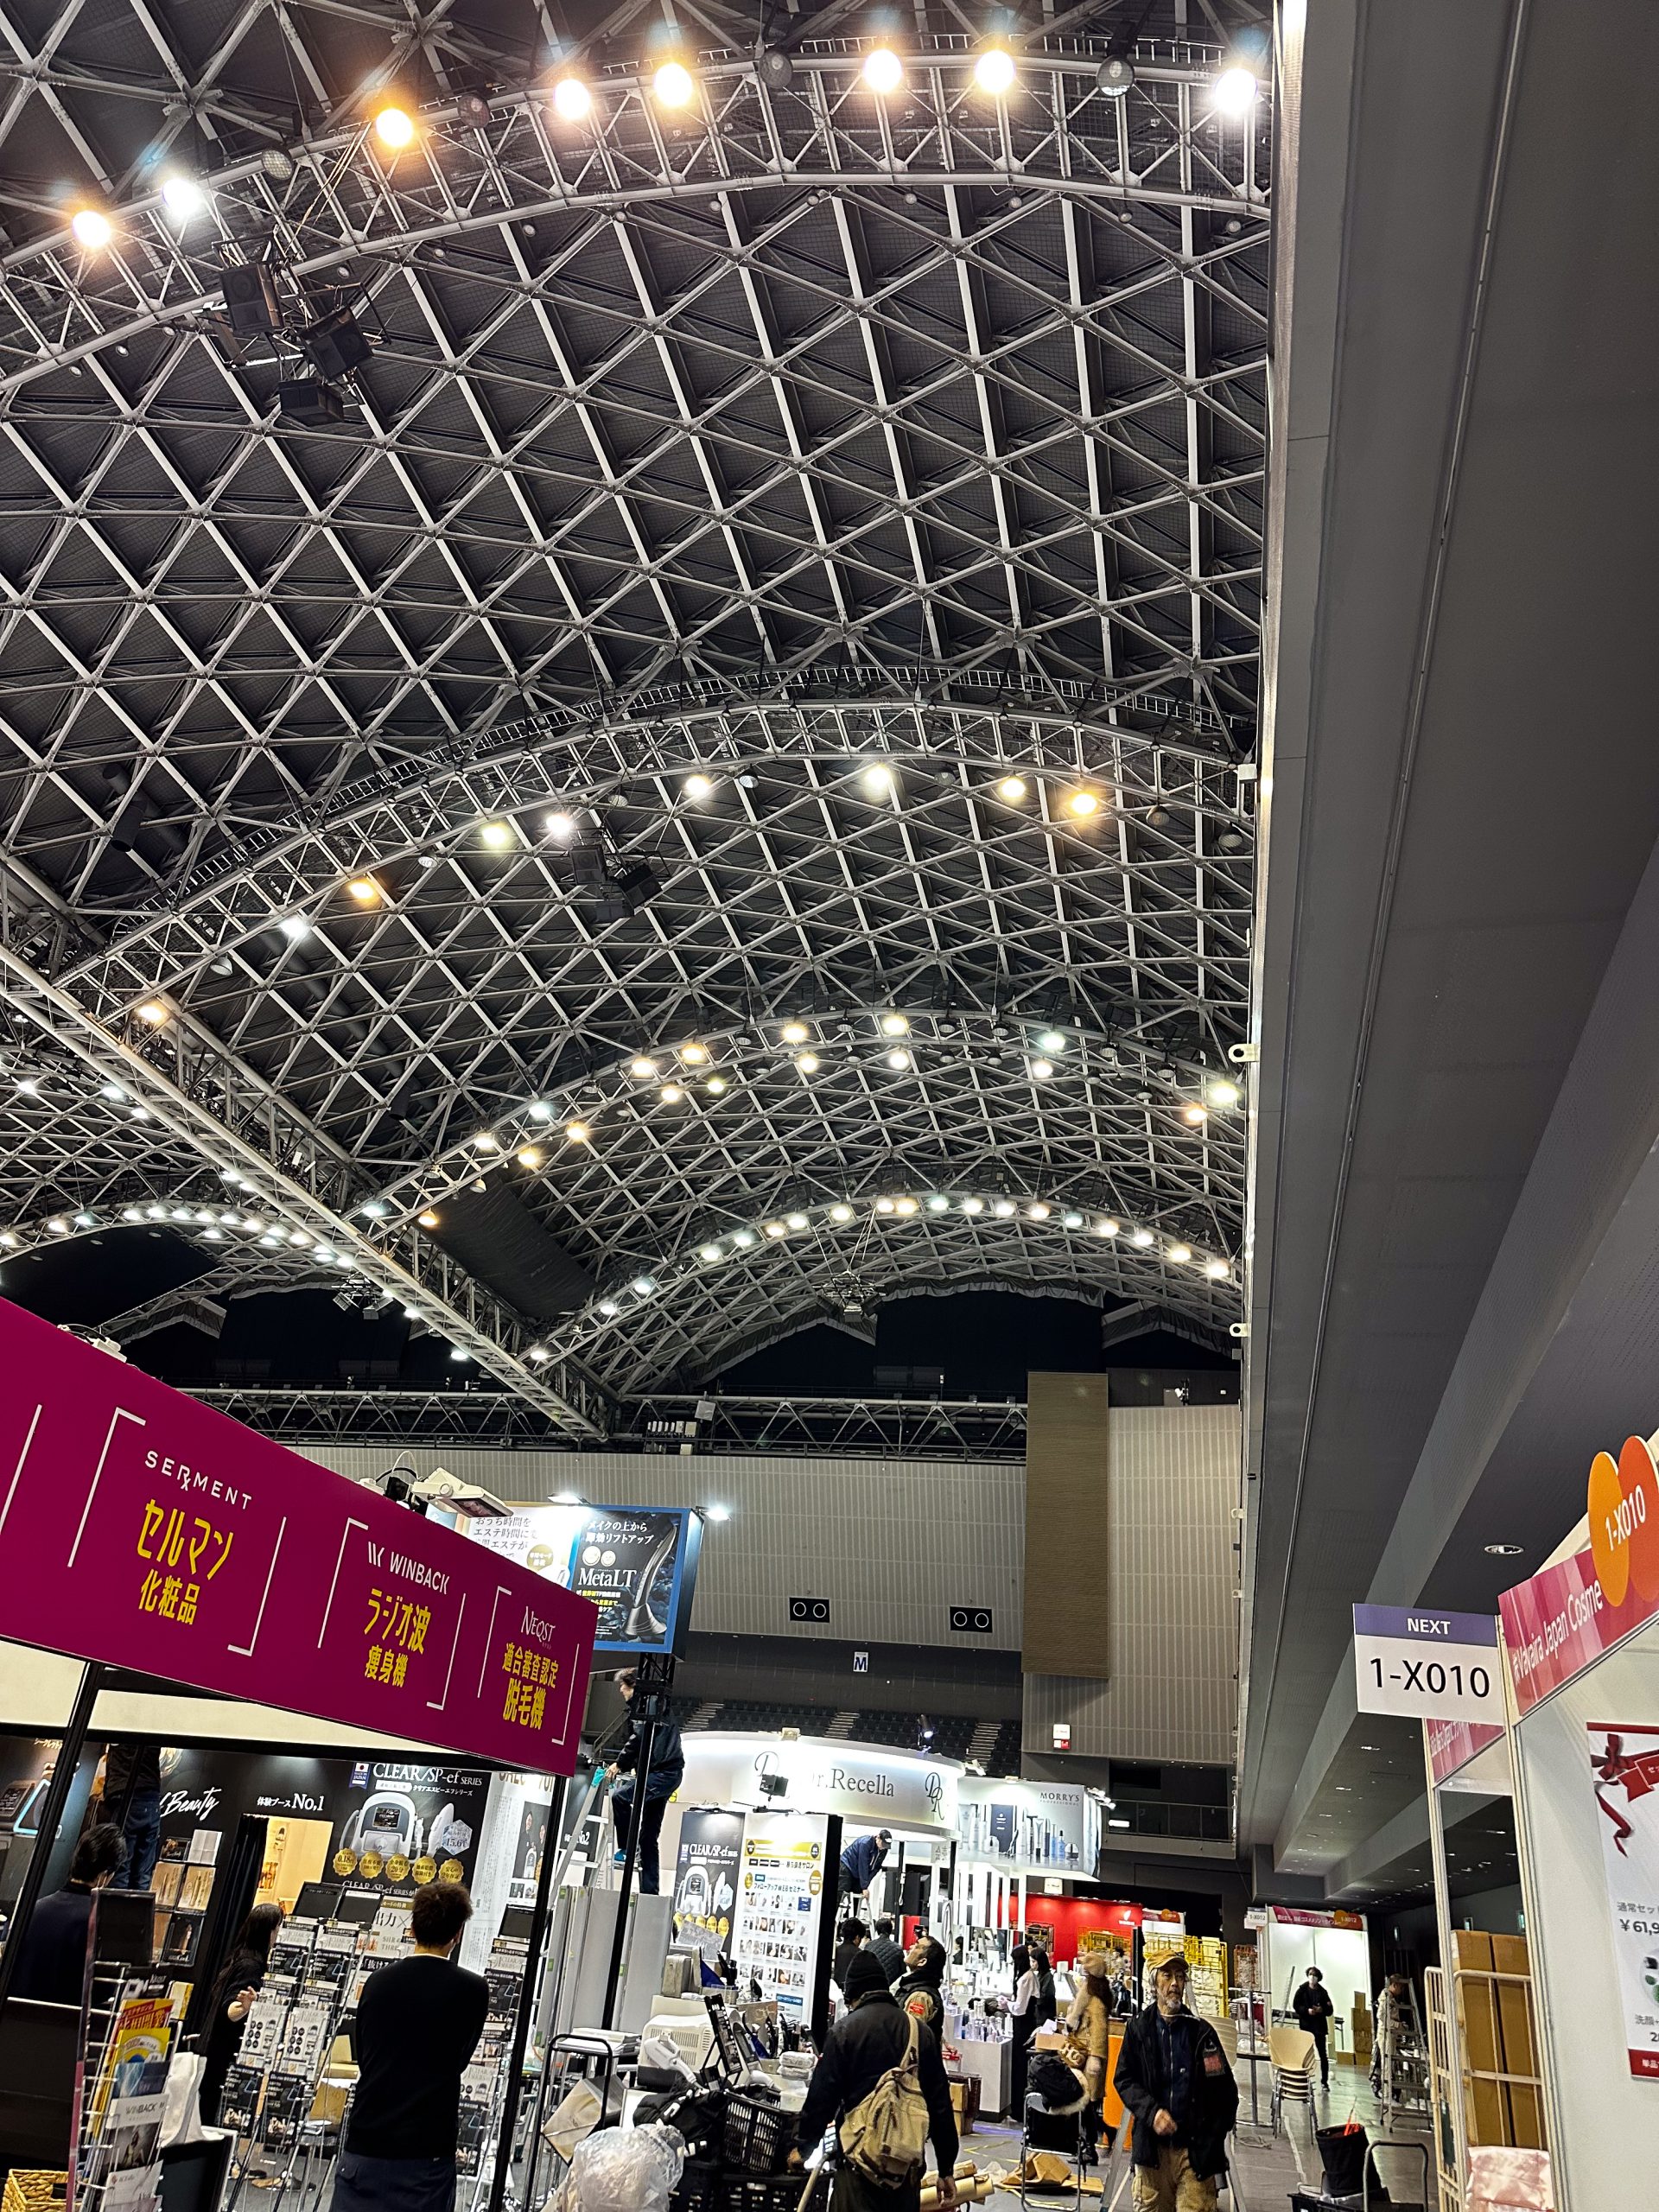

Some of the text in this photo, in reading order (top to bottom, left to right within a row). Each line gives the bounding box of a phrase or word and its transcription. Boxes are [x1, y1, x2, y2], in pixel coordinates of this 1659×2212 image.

[137, 1498, 234, 1580] セルマン
[1605, 1484, 1647, 1552] 1-X010
[390, 1551, 449, 1595] WINBACK
[578, 1568, 637, 1587] MetaLT
[138, 1568, 200, 1625] 化粧品
[364, 1588, 431, 1655] ラジオ波
[520, 1605, 556, 1643] NEQST
[1407, 1618, 1451, 1635] NEXT
[1543, 1609, 1570, 1660] Japan
[1566, 1579, 1605, 1632] Cosme
[365, 1644, 409, 1688] 痩身機
[502, 1643, 559, 1688] 適合審査認定
[854, 1656, 868, 1671] M
[1370, 1657, 1491, 1698] 1-X010
[502, 1677, 547, 1731] 脱毛機
[460, 1777, 483, 1786] SERIES
[812, 1768, 895, 1797] r.Recella
[1040, 1792, 1079, 1802] MORRY'S
[1617, 1901, 1659, 1915] 通常セッ
